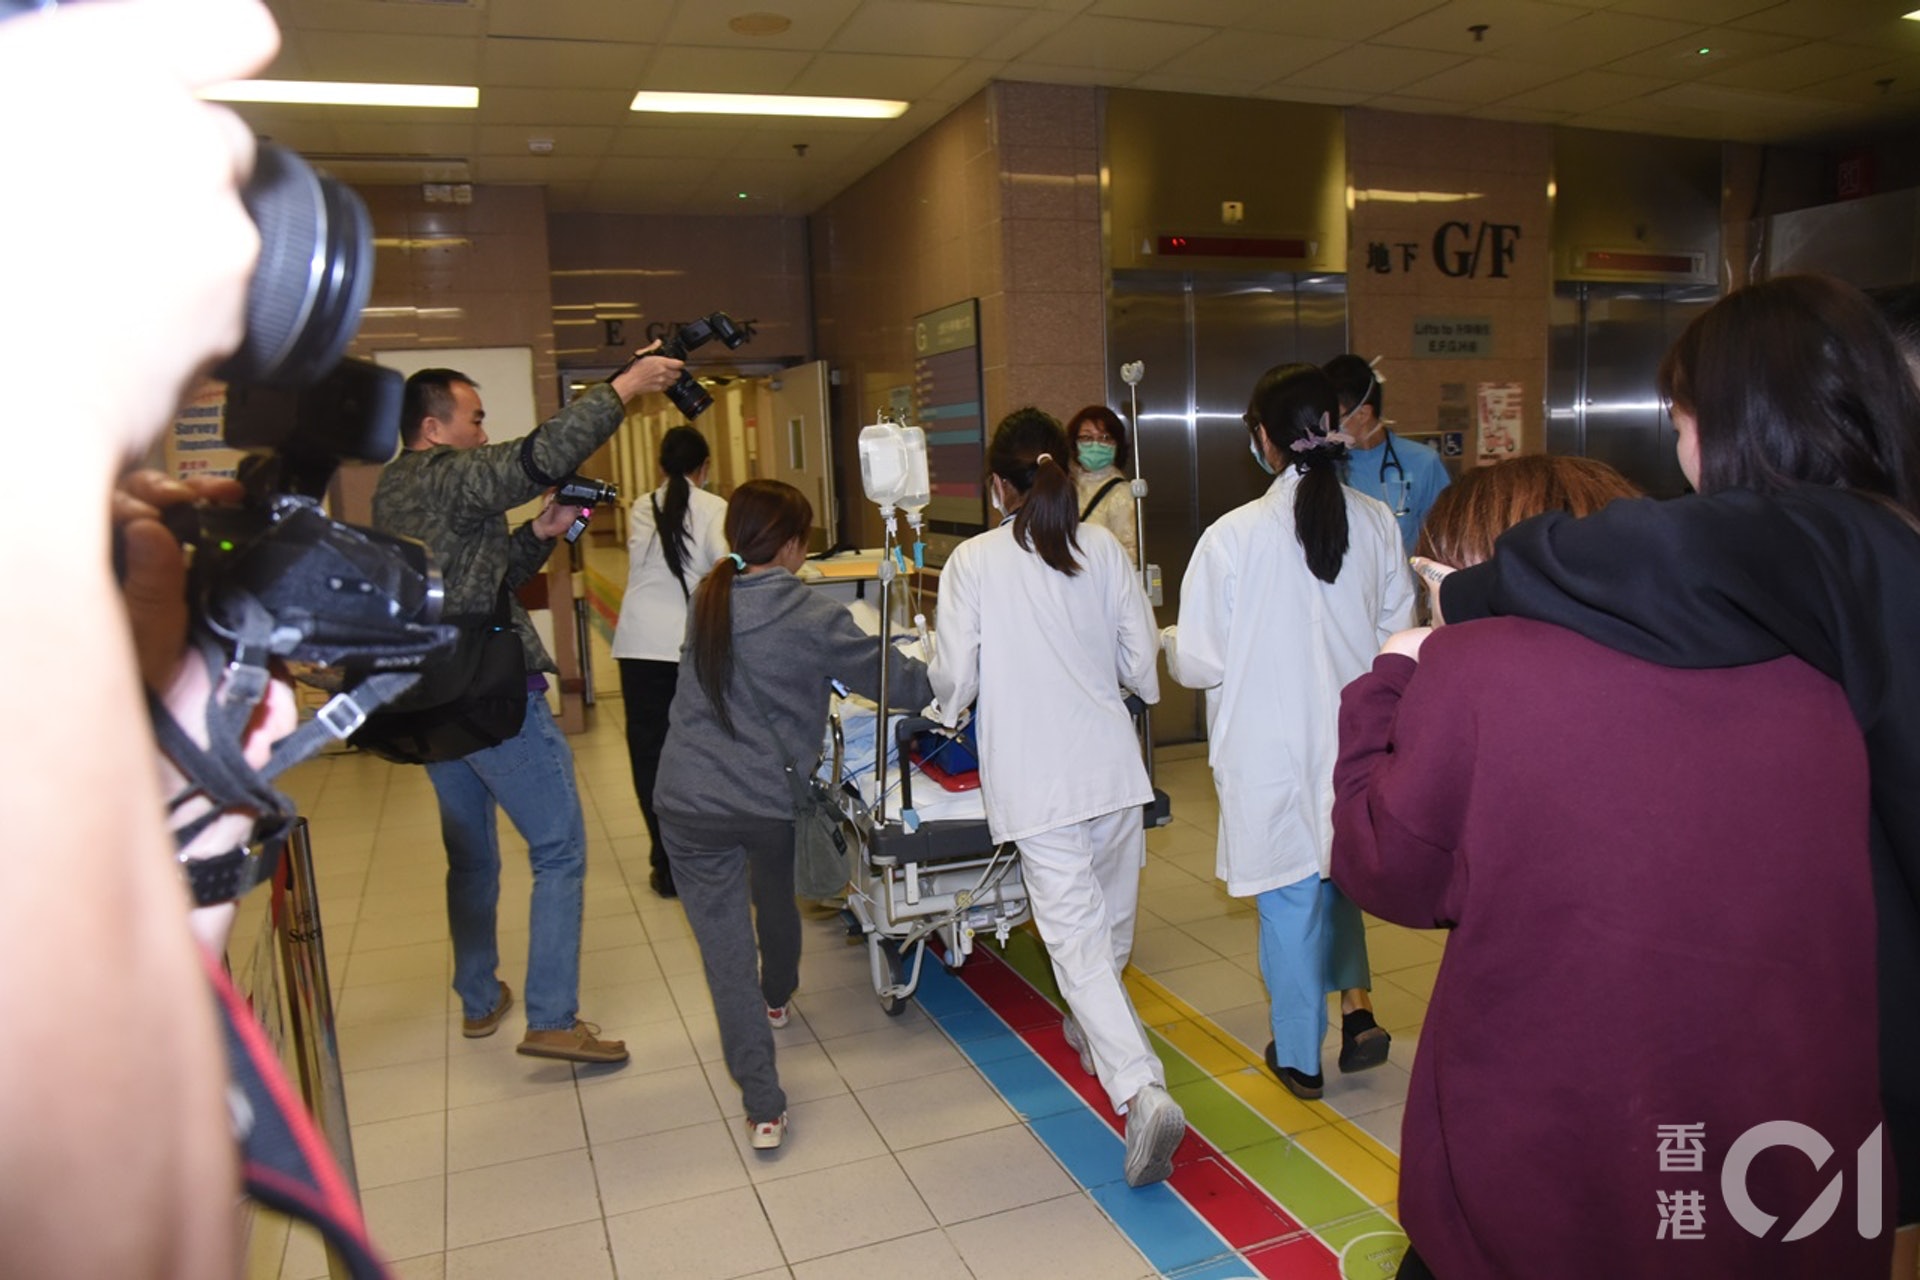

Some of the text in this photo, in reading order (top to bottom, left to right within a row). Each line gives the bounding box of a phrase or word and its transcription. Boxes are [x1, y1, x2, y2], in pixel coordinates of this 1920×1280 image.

[1366, 220, 1520, 279] 地下 G/F
[605, 319, 625, 346] E
[915, 322, 928, 351] G
[174, 423, 218, 436] Survey
